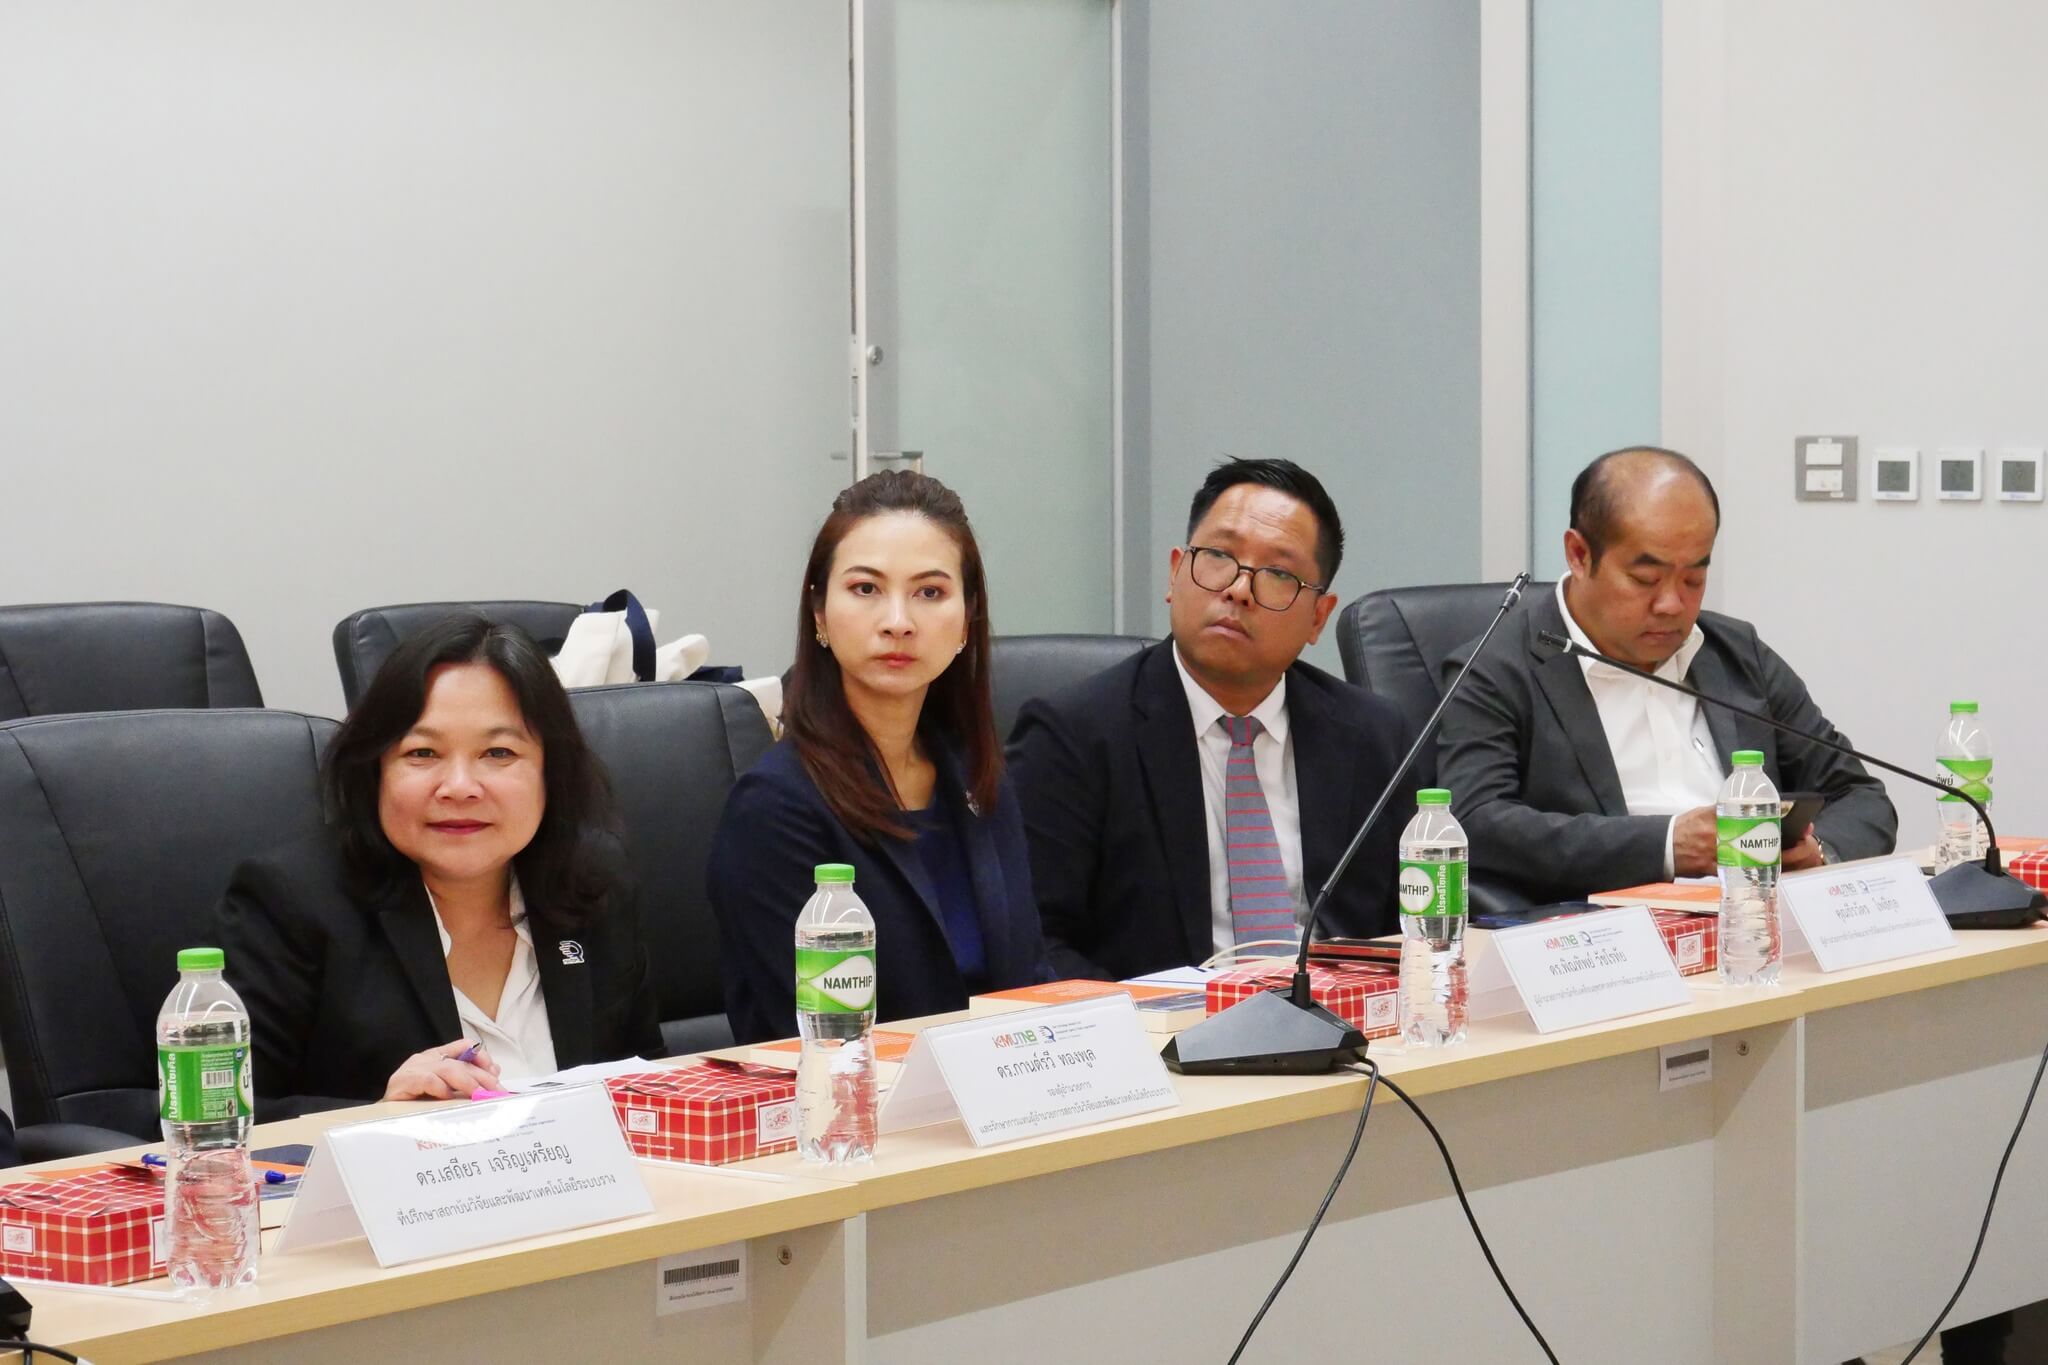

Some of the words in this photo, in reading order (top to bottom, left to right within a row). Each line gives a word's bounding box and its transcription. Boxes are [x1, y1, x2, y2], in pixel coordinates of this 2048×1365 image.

[824, 975, 872, 989] NAMTHIP
[992, 1029, 1037, 1048] KMUTNB
[997, 1050, 1056, 1079] ดร.กานต์รวี
[1057, 1048, 1097, 1069] ทองพูล
[416, 1156, 482, 1186] ดร.เสถียร
[487, 1141, 573, 1173] เจริญเหรียญ
[396, 1174, 617, 1227] ที่ปรึกษาสถาบันวิจัยและพัฒนาเทคโนโลยีระบบราง
